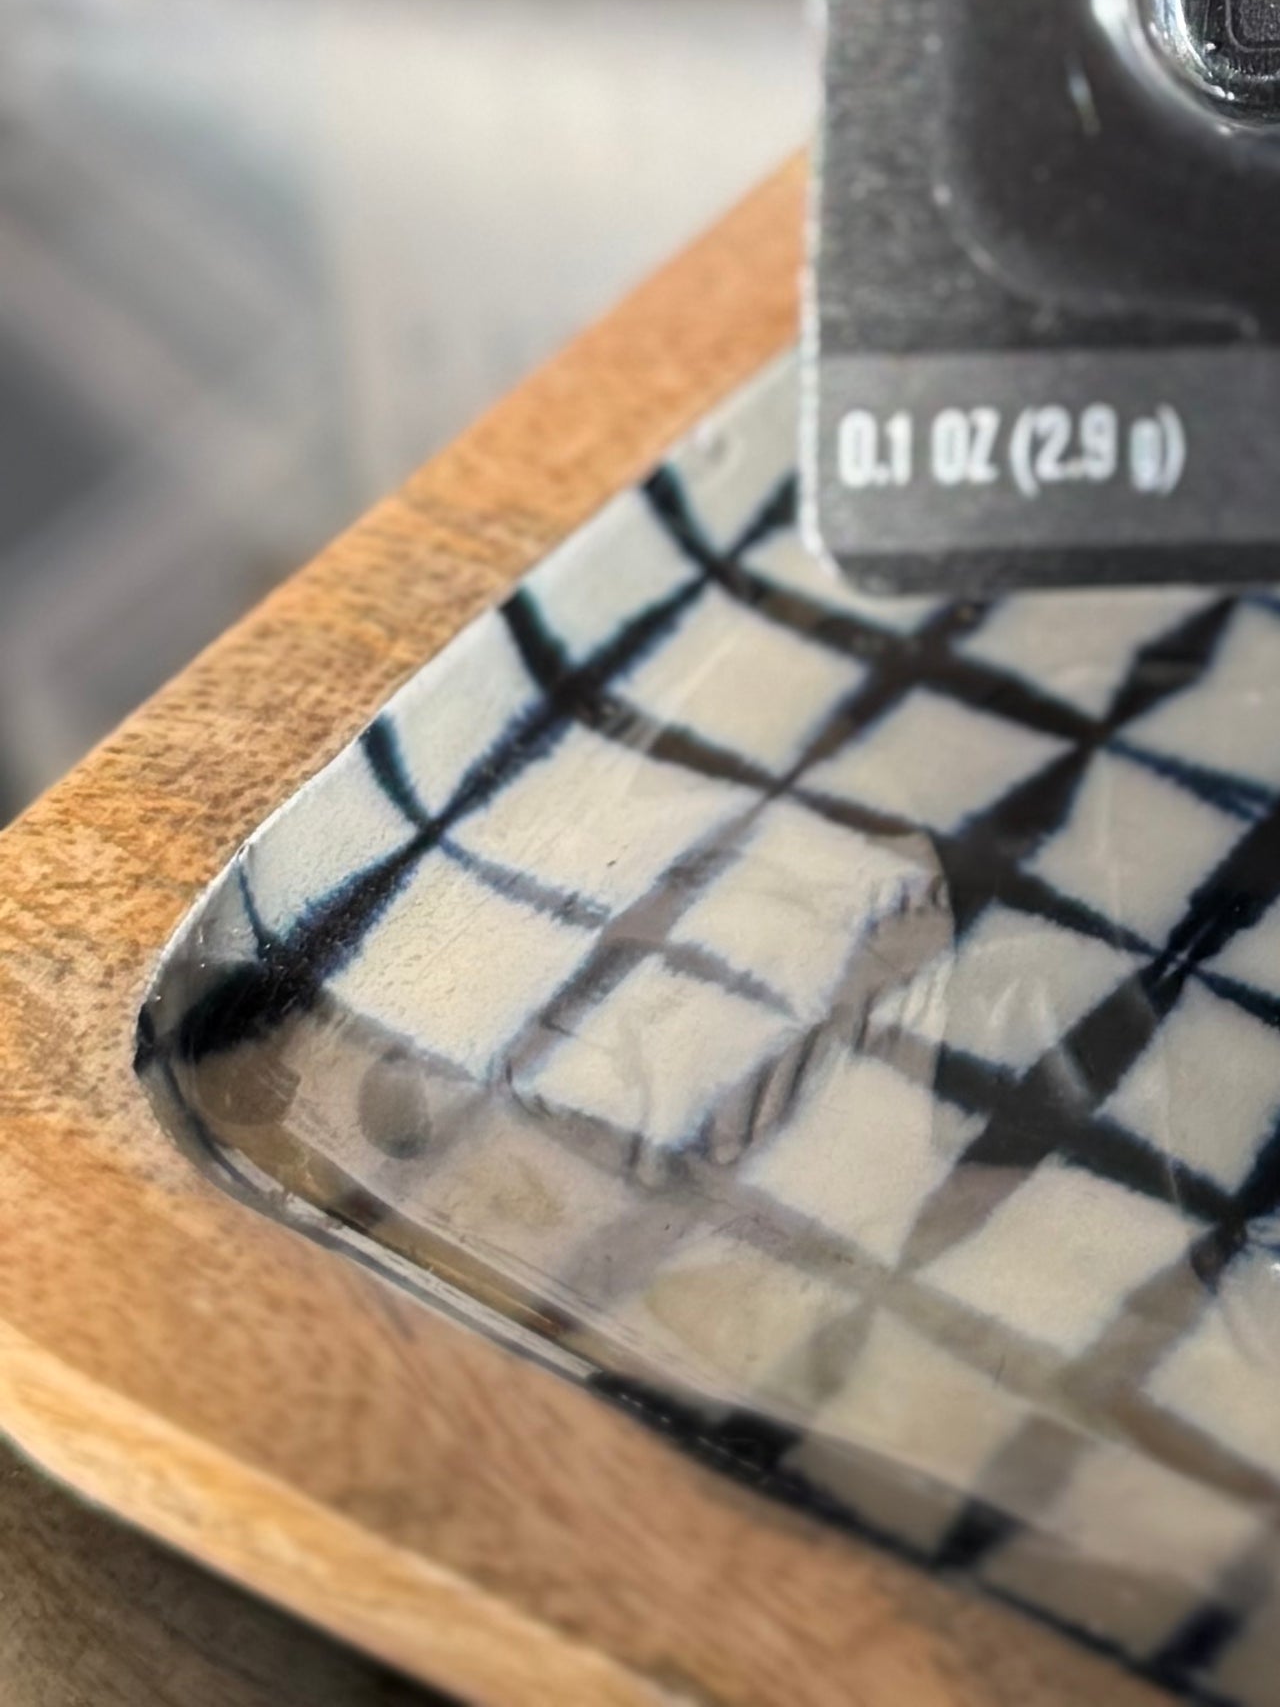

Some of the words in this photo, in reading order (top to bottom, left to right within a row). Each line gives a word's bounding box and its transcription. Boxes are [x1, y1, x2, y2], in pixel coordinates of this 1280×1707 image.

[837, 407, 914, 487] 0.1
[930, 405, 1001, 485] OZ
[1008, 399, 1119, 499] (2.9
